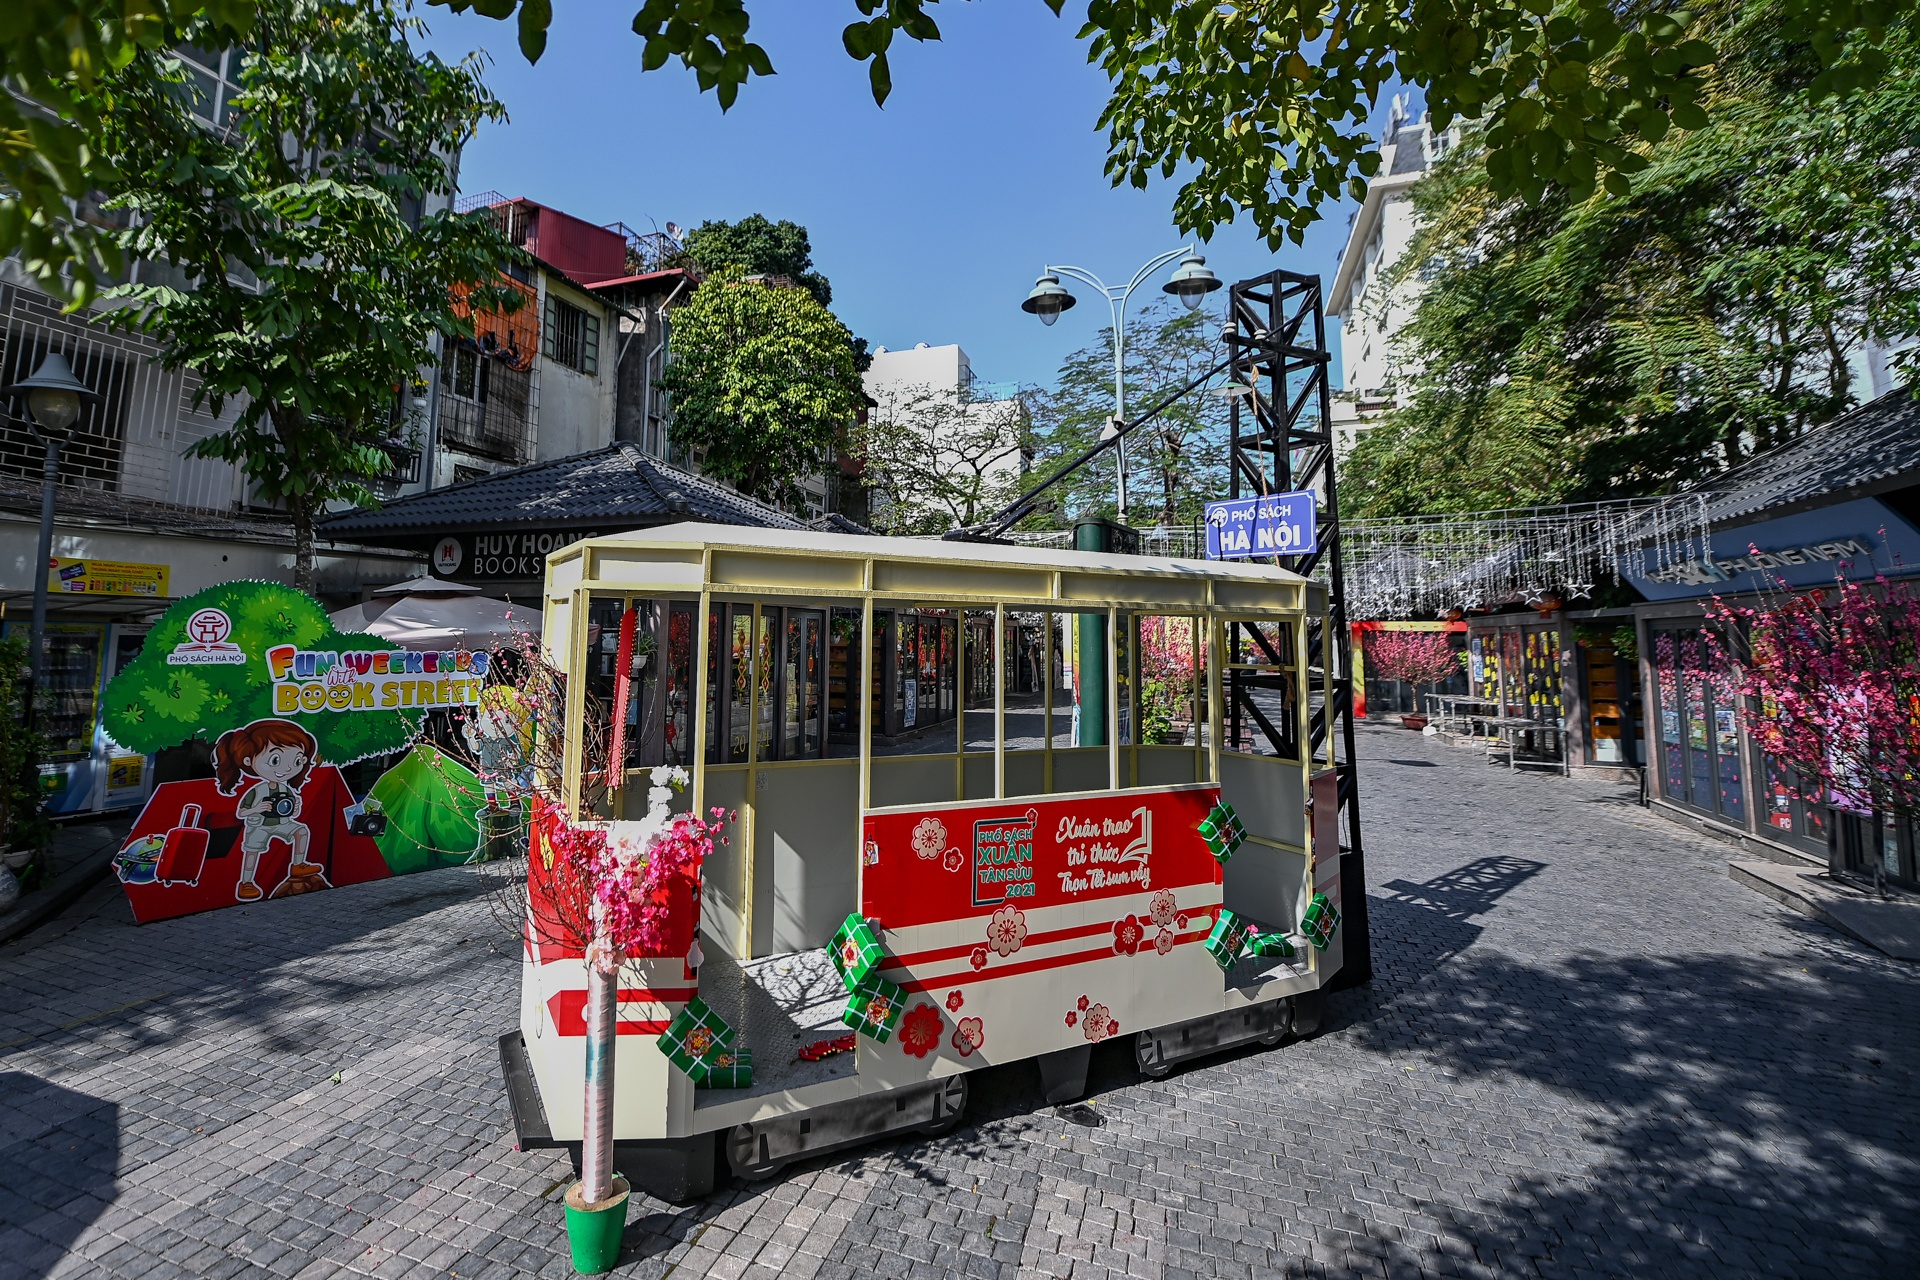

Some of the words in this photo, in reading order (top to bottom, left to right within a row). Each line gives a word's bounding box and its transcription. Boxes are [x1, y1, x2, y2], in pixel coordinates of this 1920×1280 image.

[1231, 504, 1256, 522] PHỐ
[1258, 504, 1292, 520] SÁCH
[475, 535, 518, 556] HUY
[521, 532, 598, 554] HOA
[1220, 524, 1251, 552] HÀ
[1257, 520, 1300, 551] NỘI
[1801, 540, 1869, 562] NAM
[474, 557, 546, 575] BOOKS
[169, 654, 189, 663] PHỐ
[190, 653, 214, 662] SÁCH
[215, 653, 228, 662] HÀ
[228, 654, 244, 663] NỘI
[270, 647, 336, 679] FUN
[343, 651, 490, 676] WEEKENDS
[327, 666, 358, 687] With
[277, 681, 375, 712] BOOK
[381, 679, 483, 708] STREET
[979, 827, 1003, 843] PHỐ
[1004, 827, 1033, 841] SÁCH
[1055, 815, 1101, 844] Xuân
[978, 840, 1033, 866] XUÂN
[979, 866, 1006, 884] TÂN
[1057, 871, 1089, 896] Trọn
[1086, 868, 1106, 889] Tết
[1105, 871, 1131, 887] sum
[1005, 882, 1036, 898] 2021
